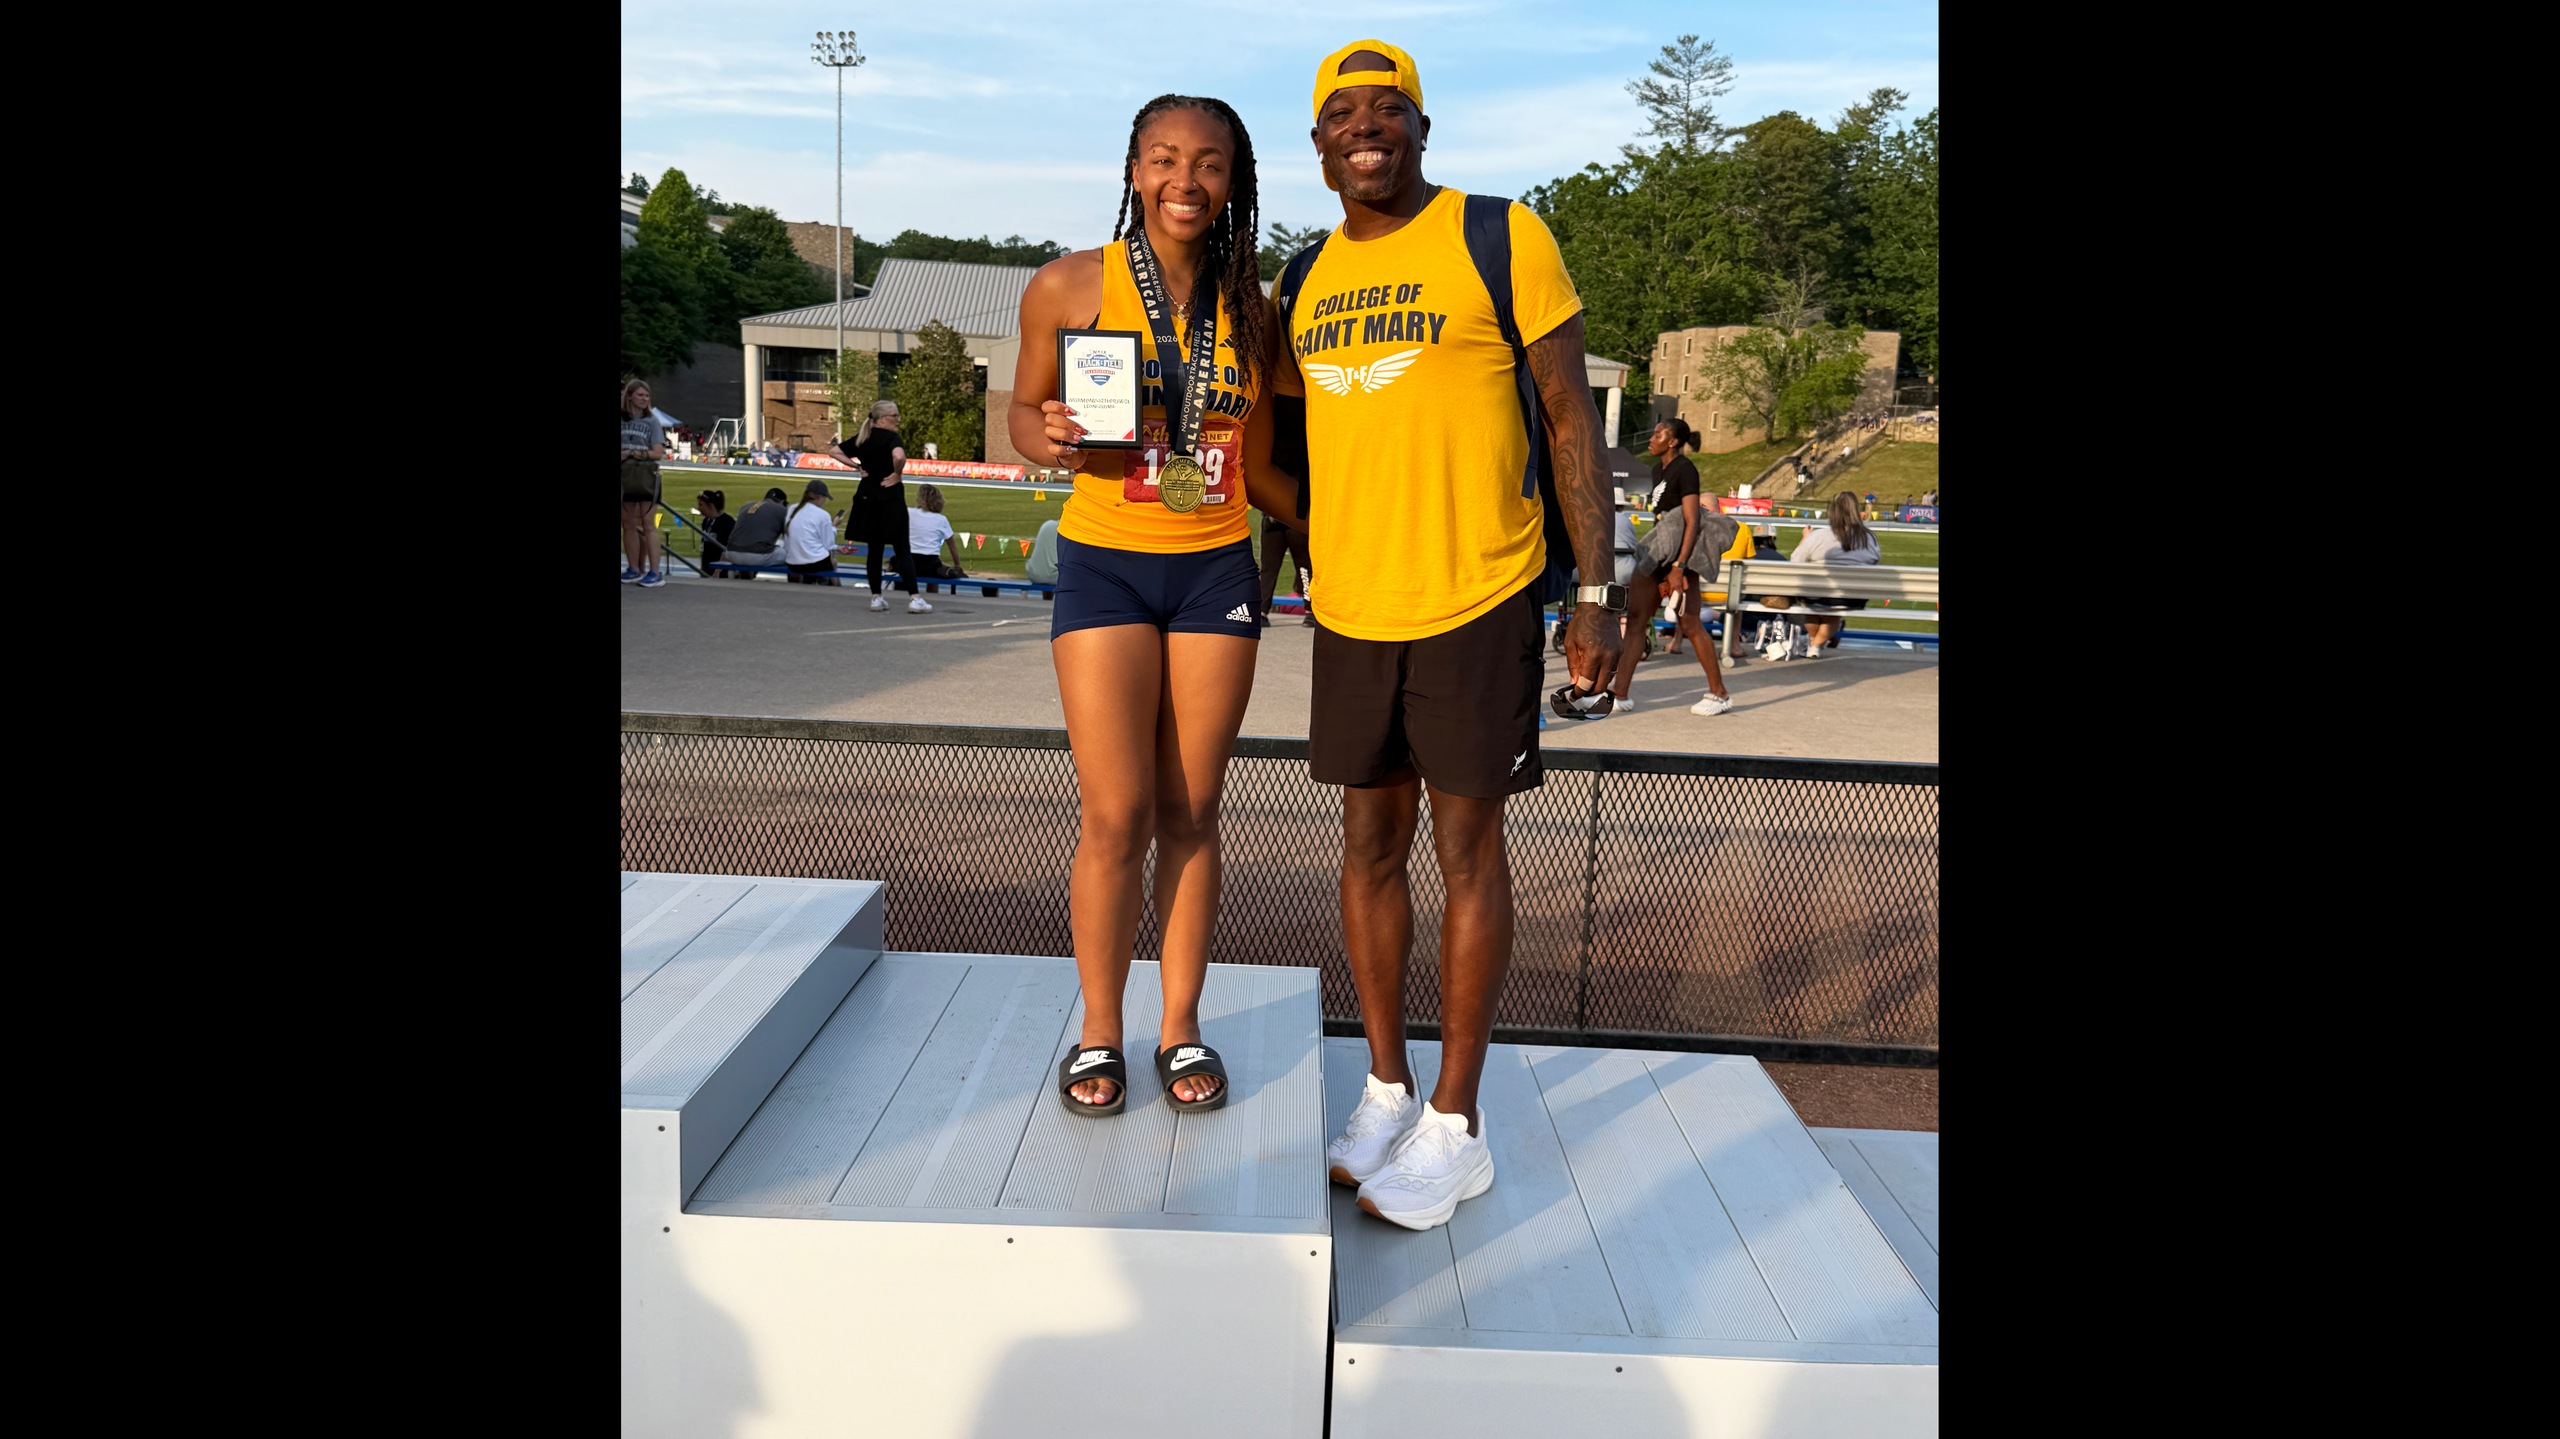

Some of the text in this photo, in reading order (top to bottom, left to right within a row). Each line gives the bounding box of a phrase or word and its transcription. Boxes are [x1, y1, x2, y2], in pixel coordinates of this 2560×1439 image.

[1147, 261, 1158, 281] TRACK
[1155, 285, 1164, 302] FIELD
[1313, 283, 1423, 321] COLLEGE OF
[1156, 335, 1178, 343] 2026
[1295, 311, 1447, 363] SAINT MARY
[1190, 352, 1199, 375] TRACK
[1345, 365, 1368, 385] T&F
[1184, 375, 1195, 413] OUTDOOR
[1181, 414, 1189, 433] NAIA
[1209, 433, 1229, 441] NET
[1226, 613, 1253, 623] adidas
[1077, 1050, 1110, 1064] NIKE
[1176, 1047, 1206, 1060] NIKE
